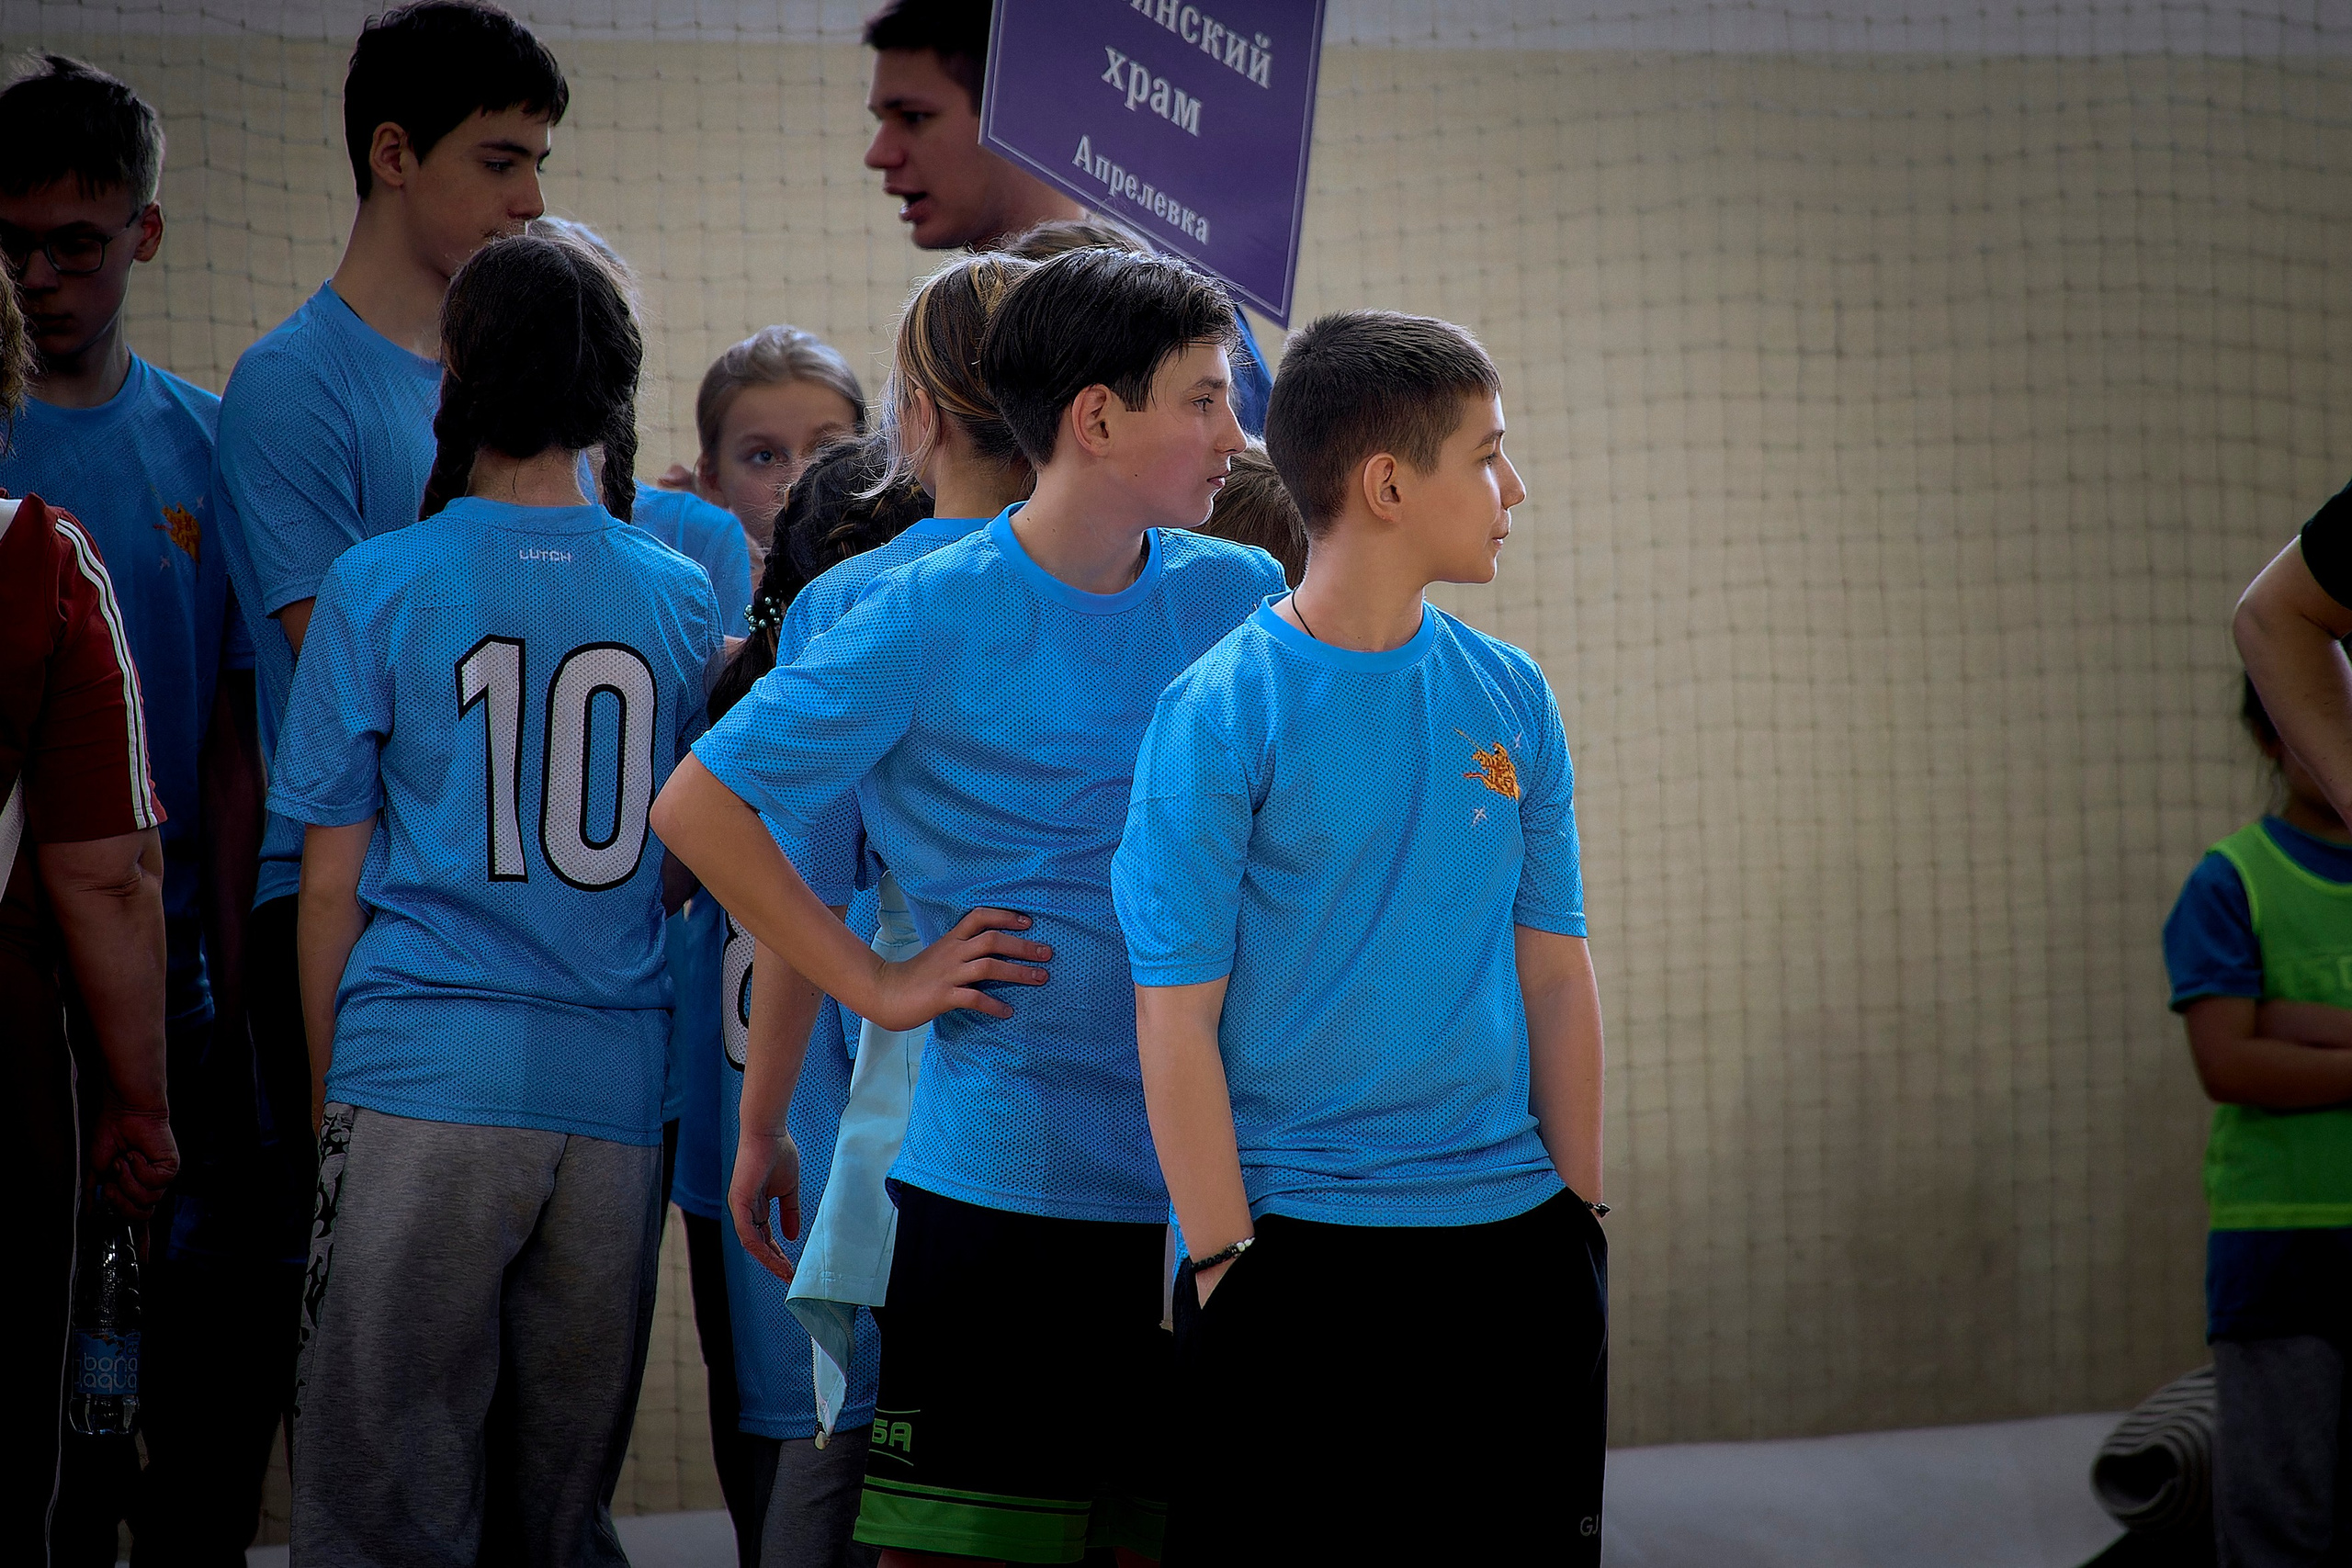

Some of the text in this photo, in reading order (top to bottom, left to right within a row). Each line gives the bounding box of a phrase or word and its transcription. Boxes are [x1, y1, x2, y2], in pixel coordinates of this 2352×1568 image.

[1102, 45, 1202, 137] храм
[1071, 134, 1211, 245] Апрелевка
[519, 548, 571, 562] LUTCH
[454, 634, 658, 892] 10
